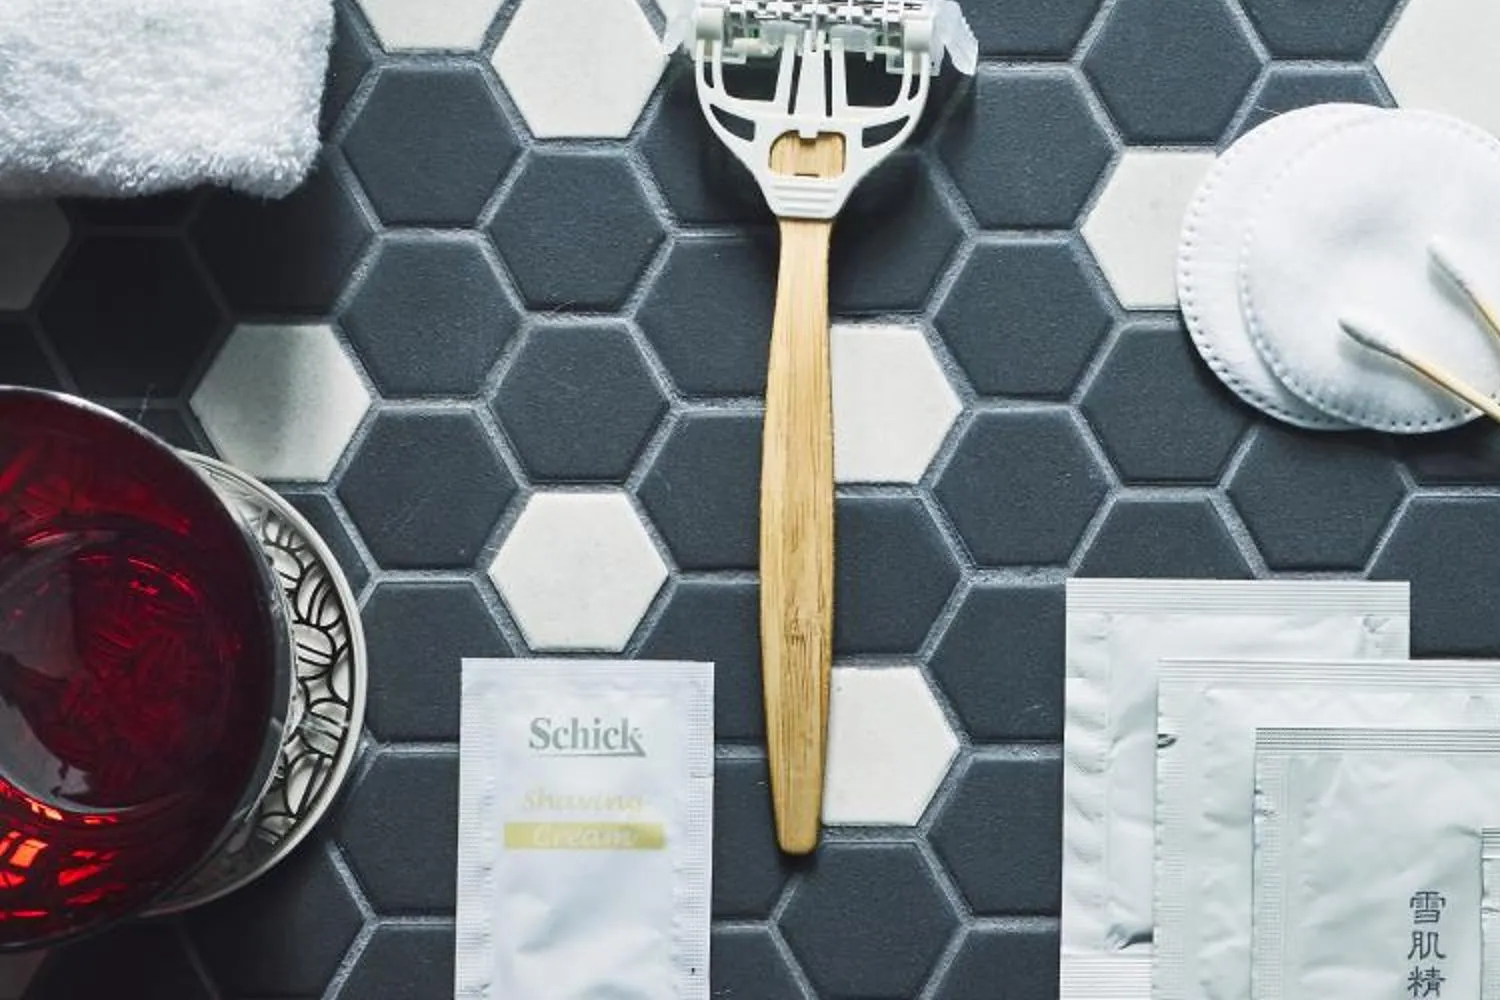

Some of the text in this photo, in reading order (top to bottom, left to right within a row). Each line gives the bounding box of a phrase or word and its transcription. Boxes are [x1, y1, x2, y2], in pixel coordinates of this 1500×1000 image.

[529, 716, 646, 757] Schick
[1407, 890, 1448, 999] 雪肌精
